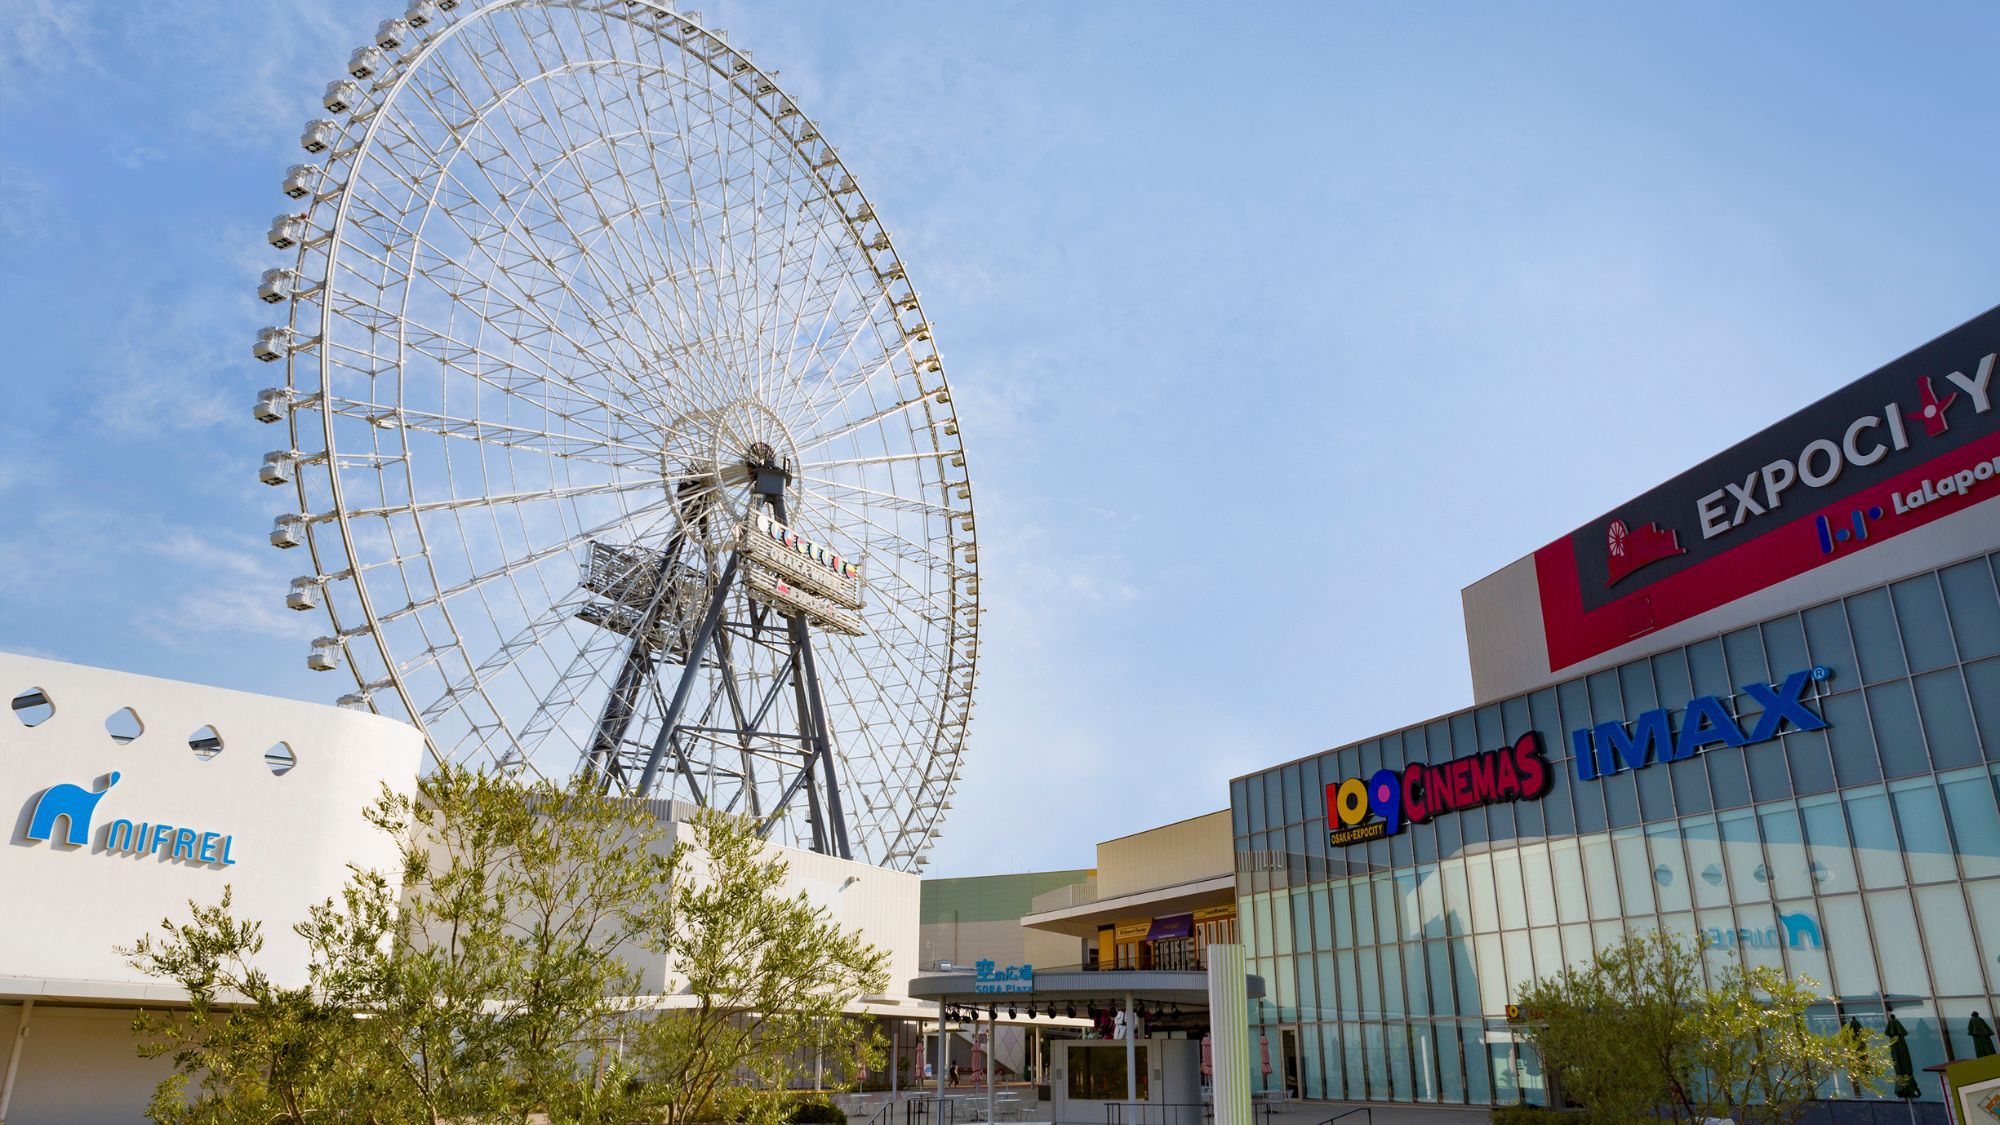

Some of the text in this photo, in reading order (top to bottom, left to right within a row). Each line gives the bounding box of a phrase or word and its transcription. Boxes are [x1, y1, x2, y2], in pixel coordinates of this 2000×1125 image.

[1326, 731, 1546, 834] 109 CINEMAS
[106, 818, 236, 865] NIFREL
[975, 983, 1033, 994] SORA Plaza
